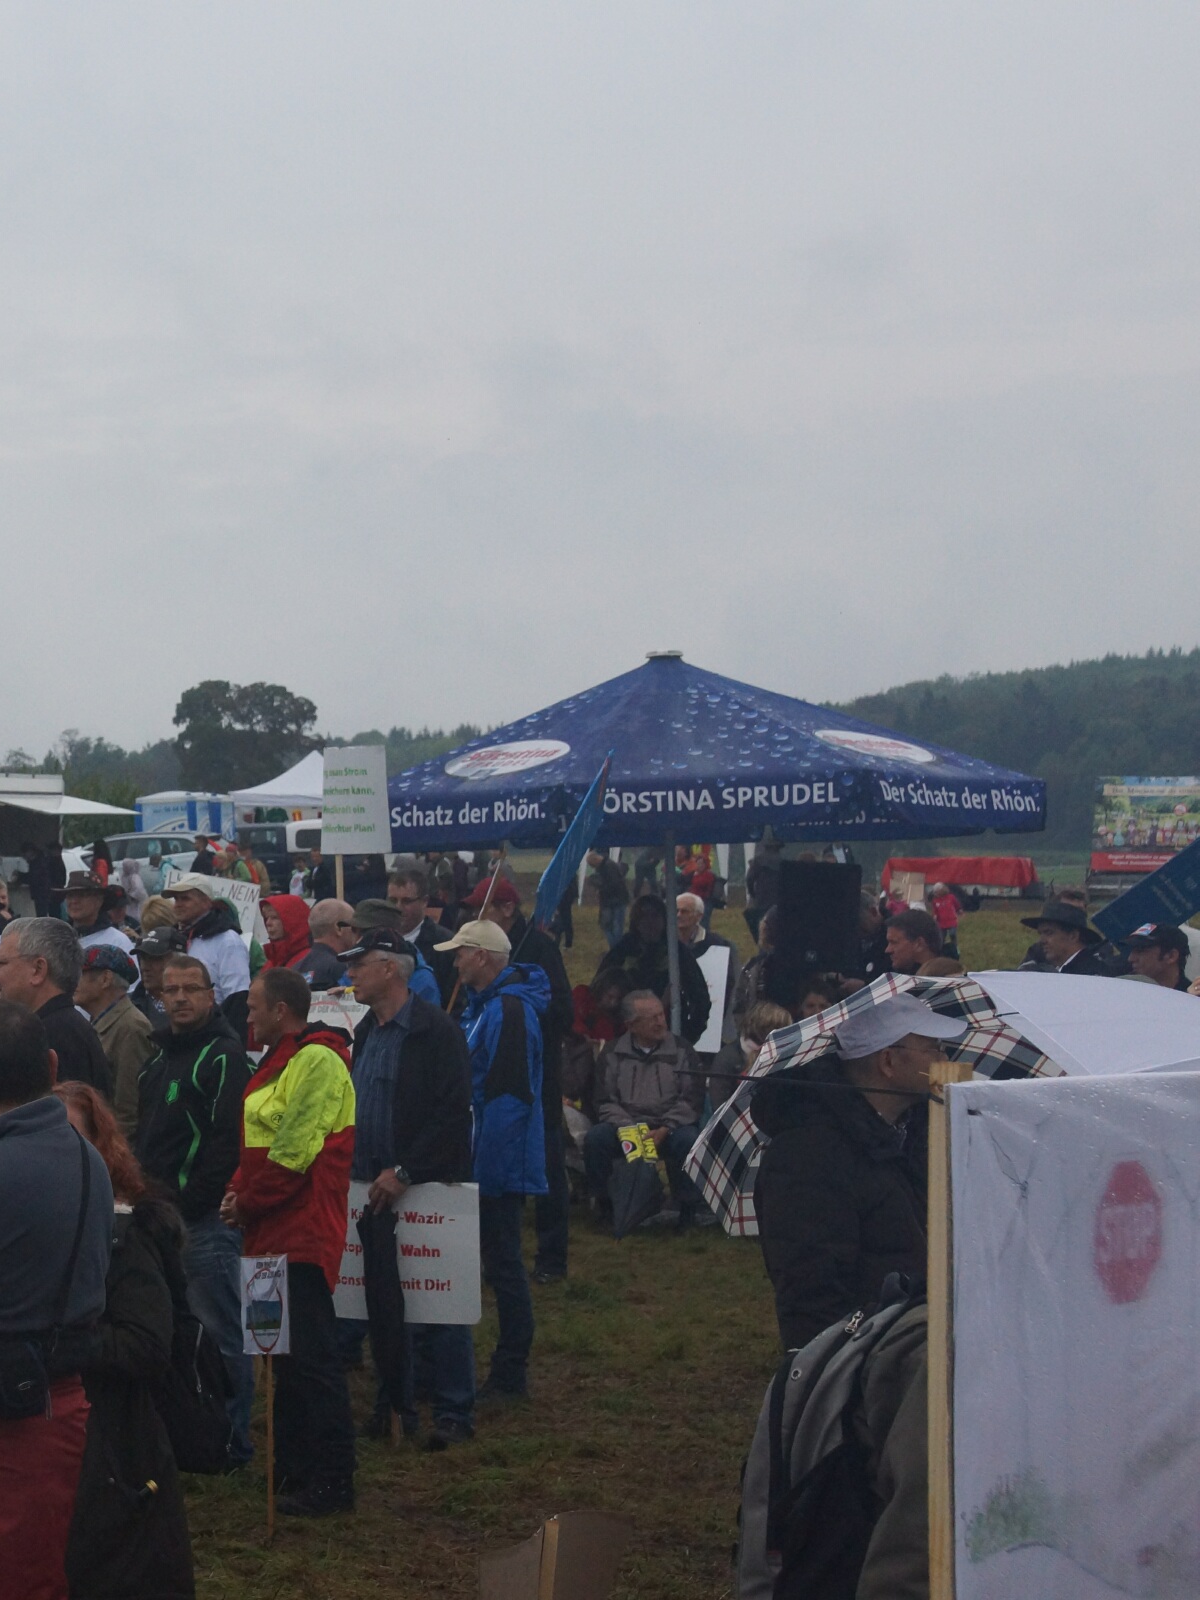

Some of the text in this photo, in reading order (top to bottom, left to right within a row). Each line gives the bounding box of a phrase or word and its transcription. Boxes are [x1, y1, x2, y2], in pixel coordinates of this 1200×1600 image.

[603, 781, 840, 814] ÖRSTINA SPRUDEL
[879, 780, 1041, 812] Der Schatz der Rhön.
[390, 799, 546, 828] Schatz der Rhön.
[228, 882, 259, 903] NEIN
[400, 1244, 441, 1258] Wahn
[425, 1279, 451, 1292] Dir!
